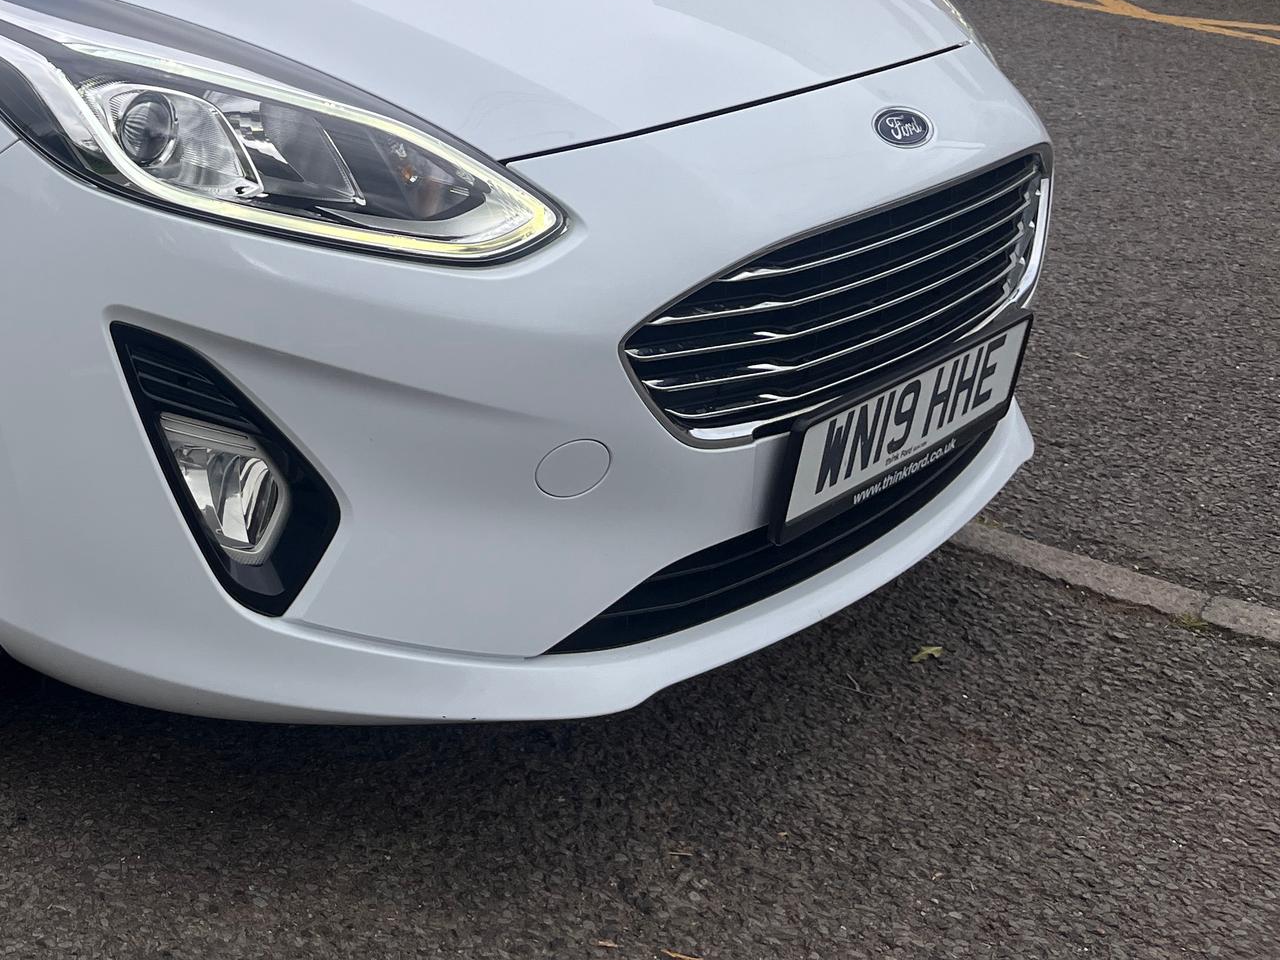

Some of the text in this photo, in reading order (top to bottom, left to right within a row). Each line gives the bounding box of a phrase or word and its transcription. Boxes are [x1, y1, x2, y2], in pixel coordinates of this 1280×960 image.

[886, 114, 922, 139] Ford
[815, 334, 1007, 494] WN19 HHE
[853, 438, 957, 505] www.thinkford.co.uk
